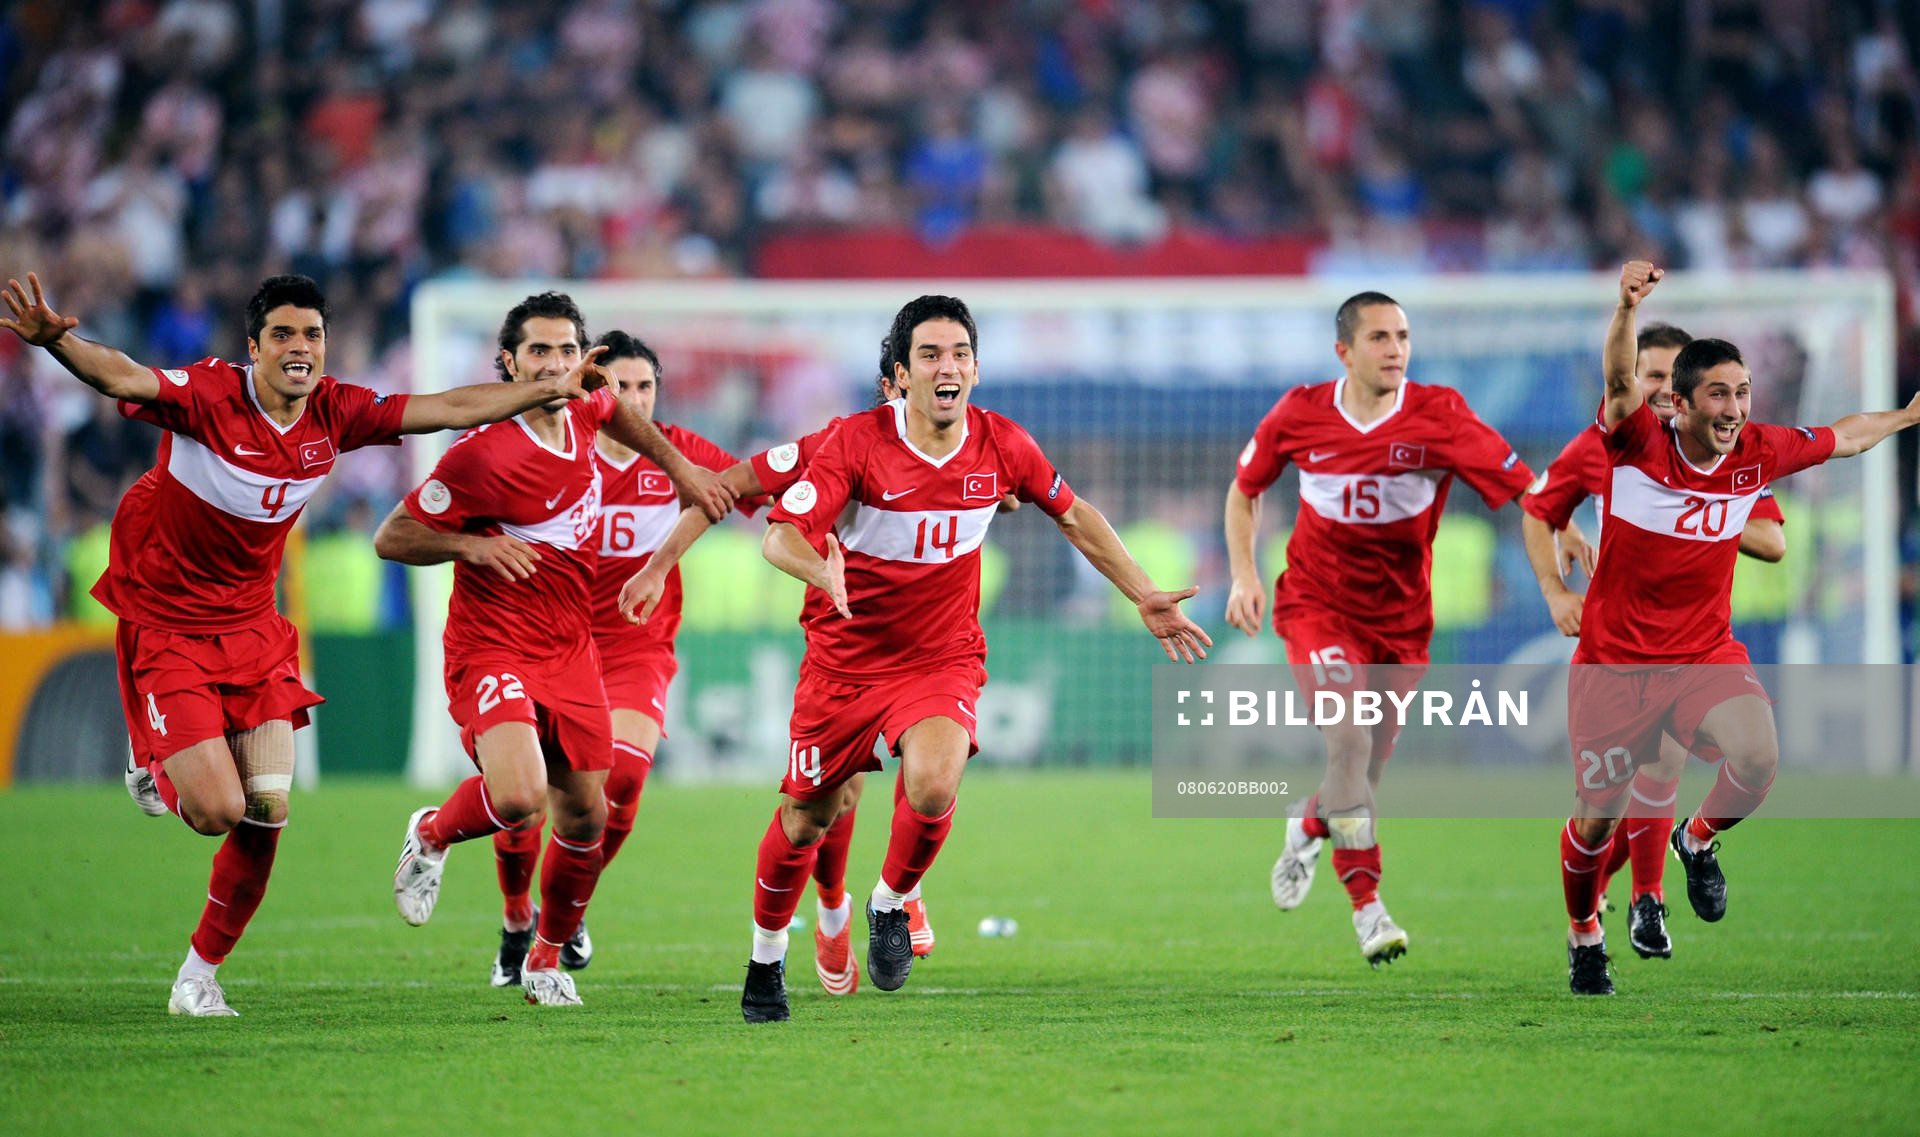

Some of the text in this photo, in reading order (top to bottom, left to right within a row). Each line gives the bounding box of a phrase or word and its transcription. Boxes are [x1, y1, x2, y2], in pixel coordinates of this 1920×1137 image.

[260, 481, 290, 519] 4
[1342, 480, 1380, 519] 15
[1674, 496, 1729, 538] 20
[913, 514, 961, 559] 14
[1309, 646, 1353, 687] 15
[146, 692, 168, 737] 4
[475, 672, 526, 716] 22
[789, 740, 825, 787] 14
[1579, 746, 1634, 790] 20
